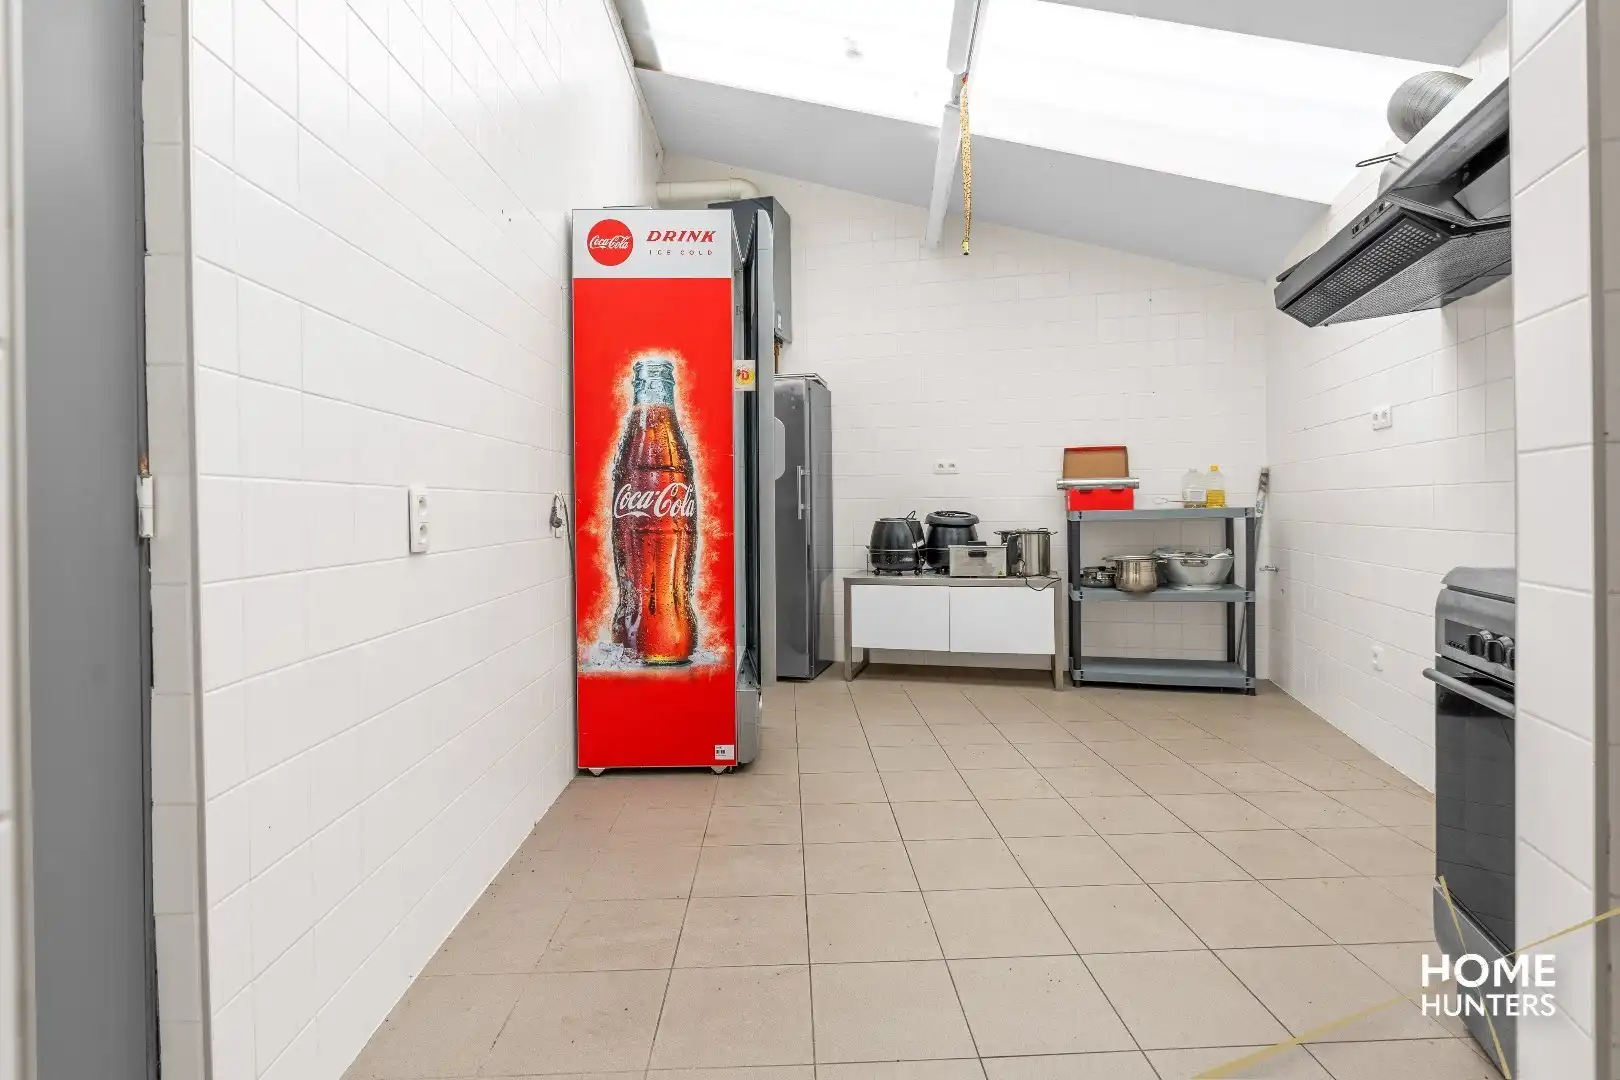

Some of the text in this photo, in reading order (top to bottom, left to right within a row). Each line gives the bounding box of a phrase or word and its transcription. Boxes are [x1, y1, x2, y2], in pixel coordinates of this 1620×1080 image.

[590, 235, 631, 249] Coca-Cola
[646, 231, 716, 242] DRINK
[614, 483, 695, 518] Coca-Cola
